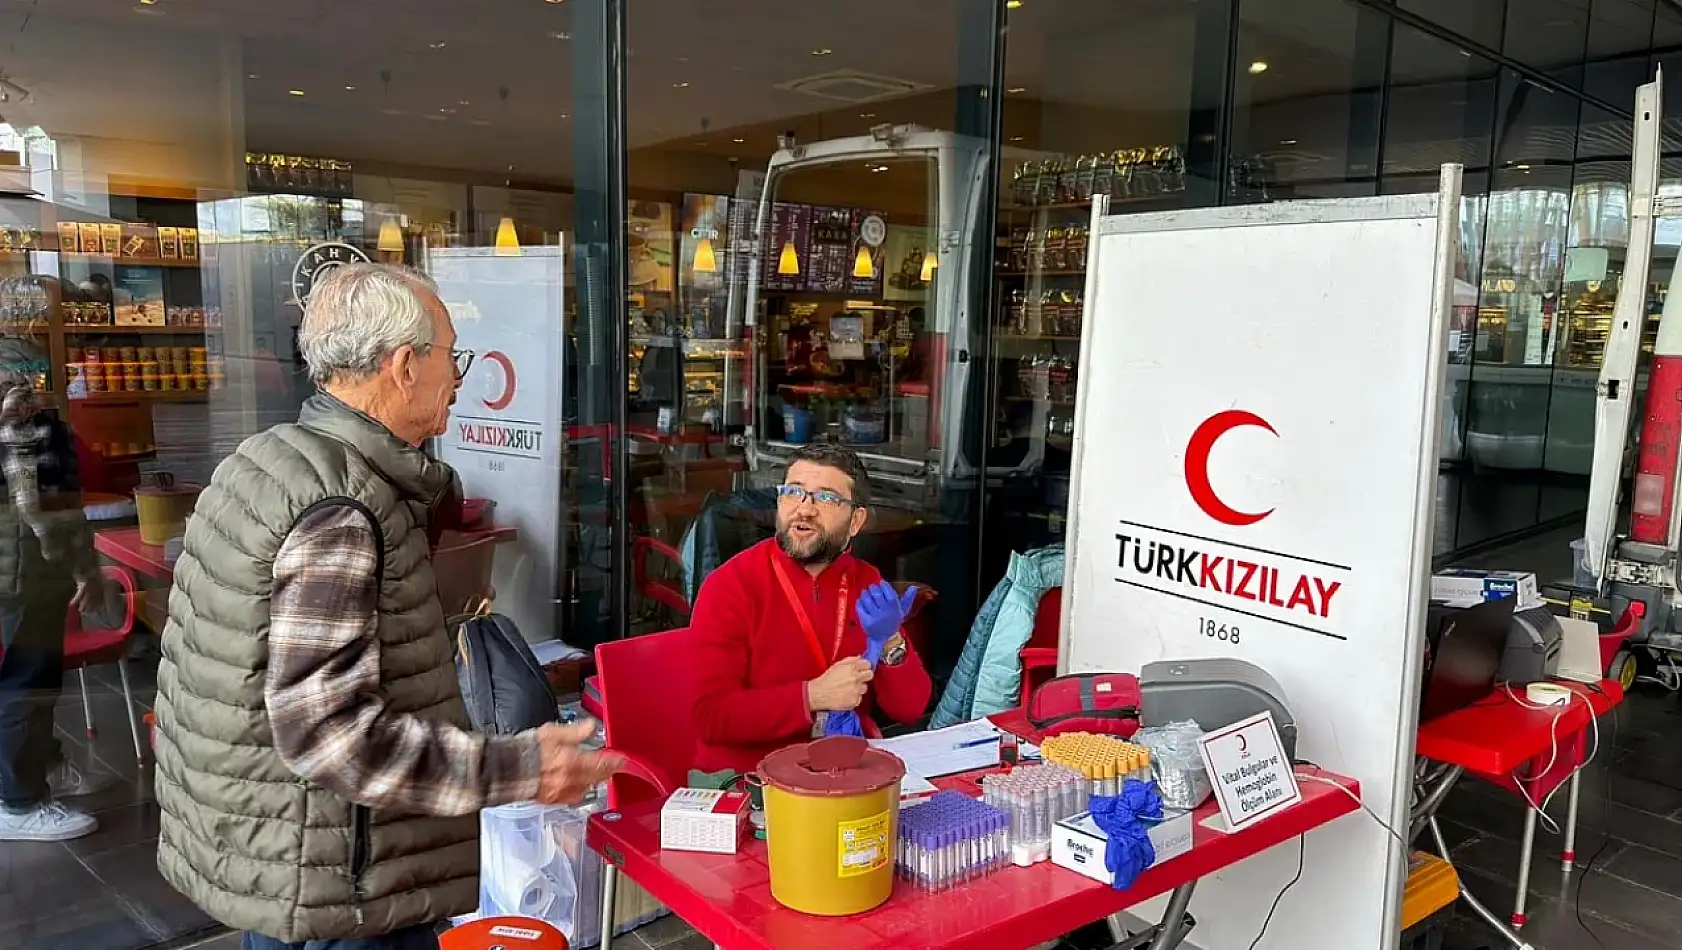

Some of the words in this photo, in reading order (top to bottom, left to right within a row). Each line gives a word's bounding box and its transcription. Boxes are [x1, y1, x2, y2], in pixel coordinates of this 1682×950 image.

[1115, 533, 1342, 618] TÜRKKIZILAY
[1198, 617, 1240, 644] 1868
[1222, 769, 1241, 785] Vital
[1240, 759, 1269, 778] Bulgular
[1269, 756, 1278, 765] ve
[1235, 773, 1278, 797] Hemoglobin
